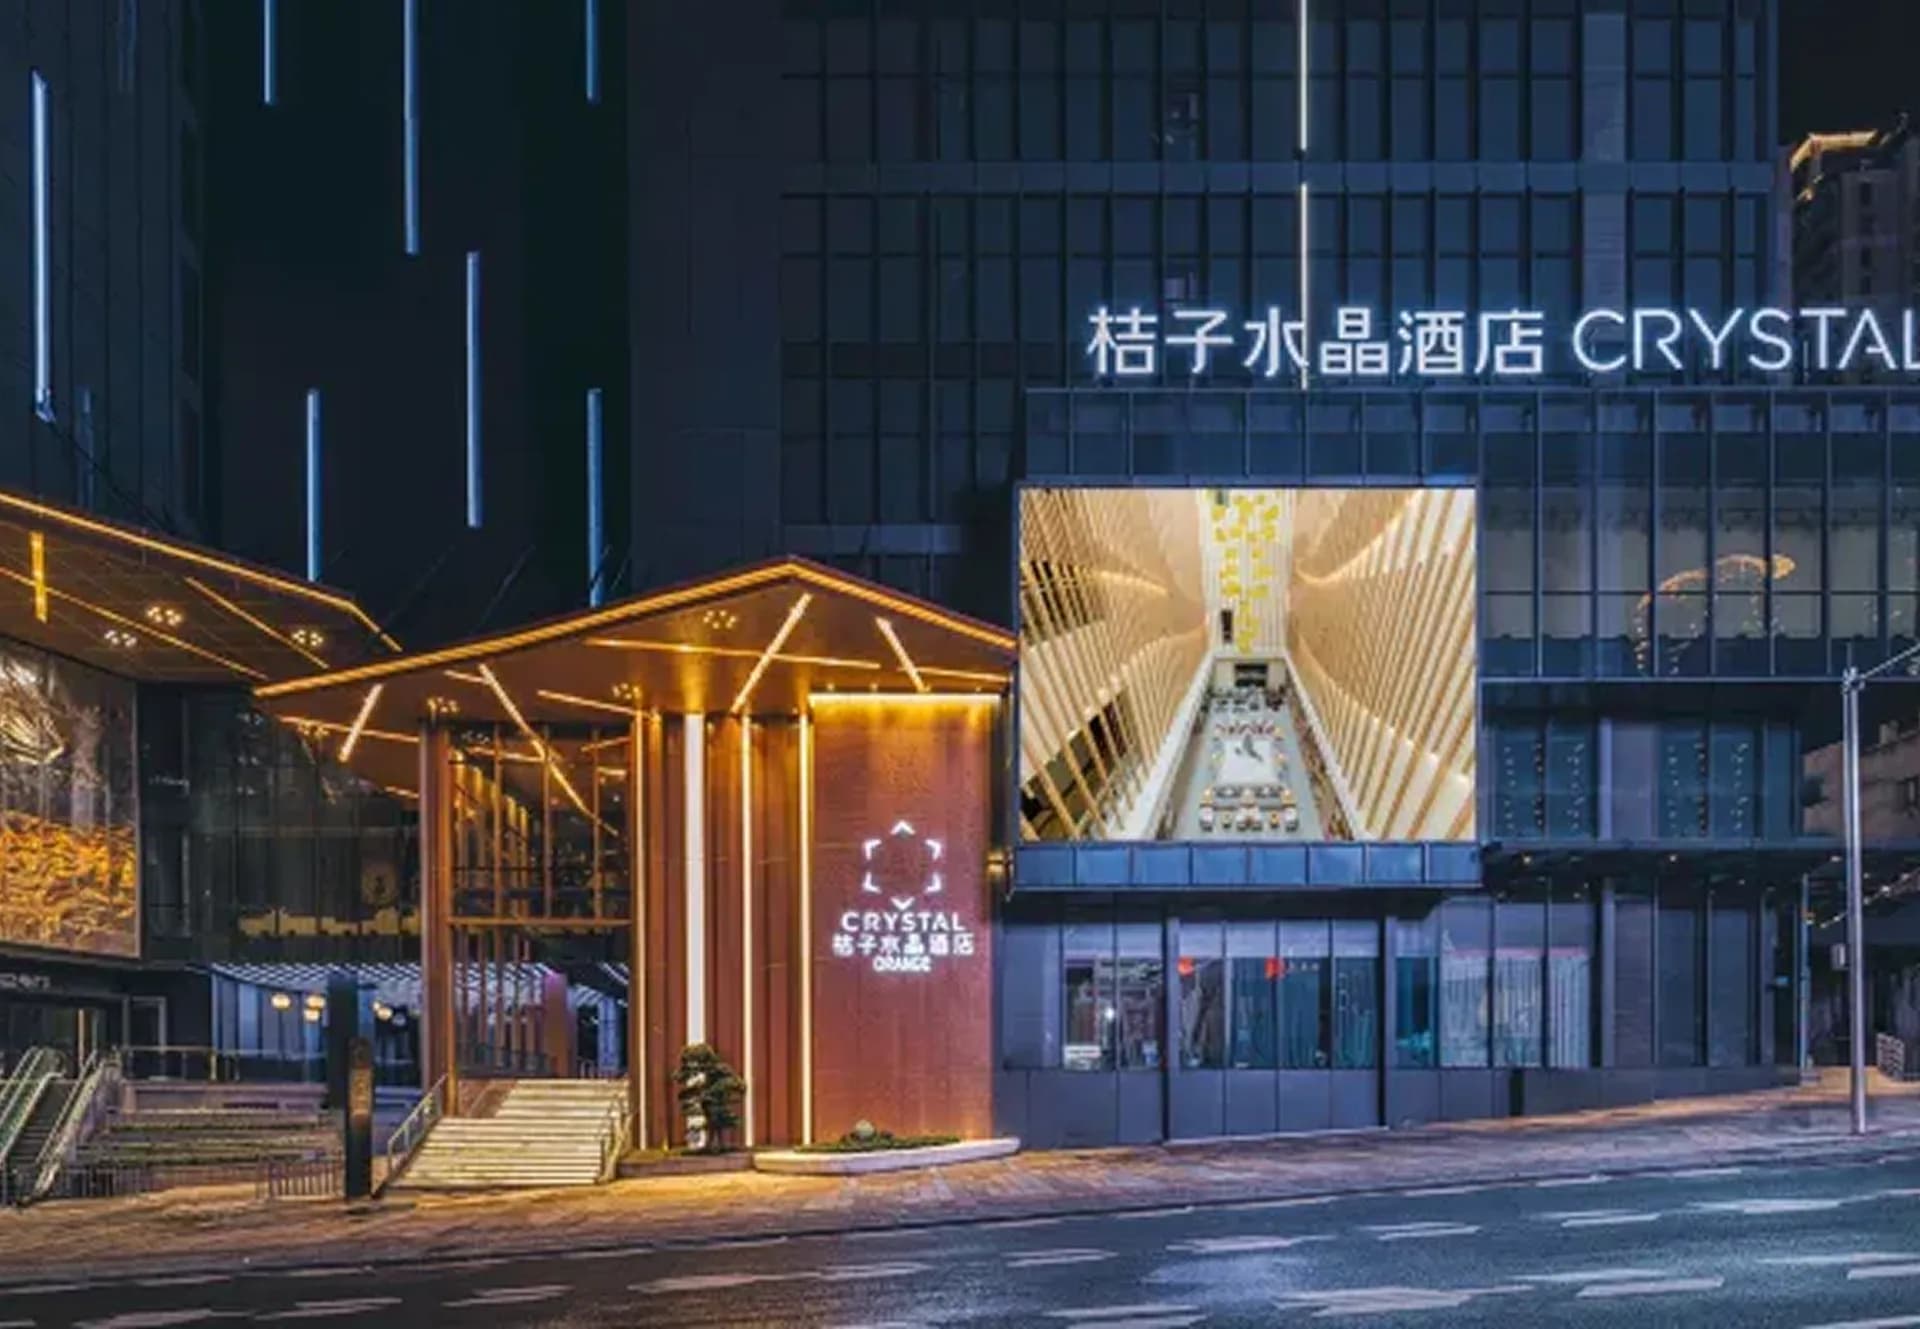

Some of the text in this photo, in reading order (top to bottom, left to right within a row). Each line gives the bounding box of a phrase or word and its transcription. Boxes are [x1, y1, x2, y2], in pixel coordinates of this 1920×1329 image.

[1086, 305, 1920, 377] 桔子水晶酒店 CRYSTAL
[840, 911, 966, 932] CRYSTAL
